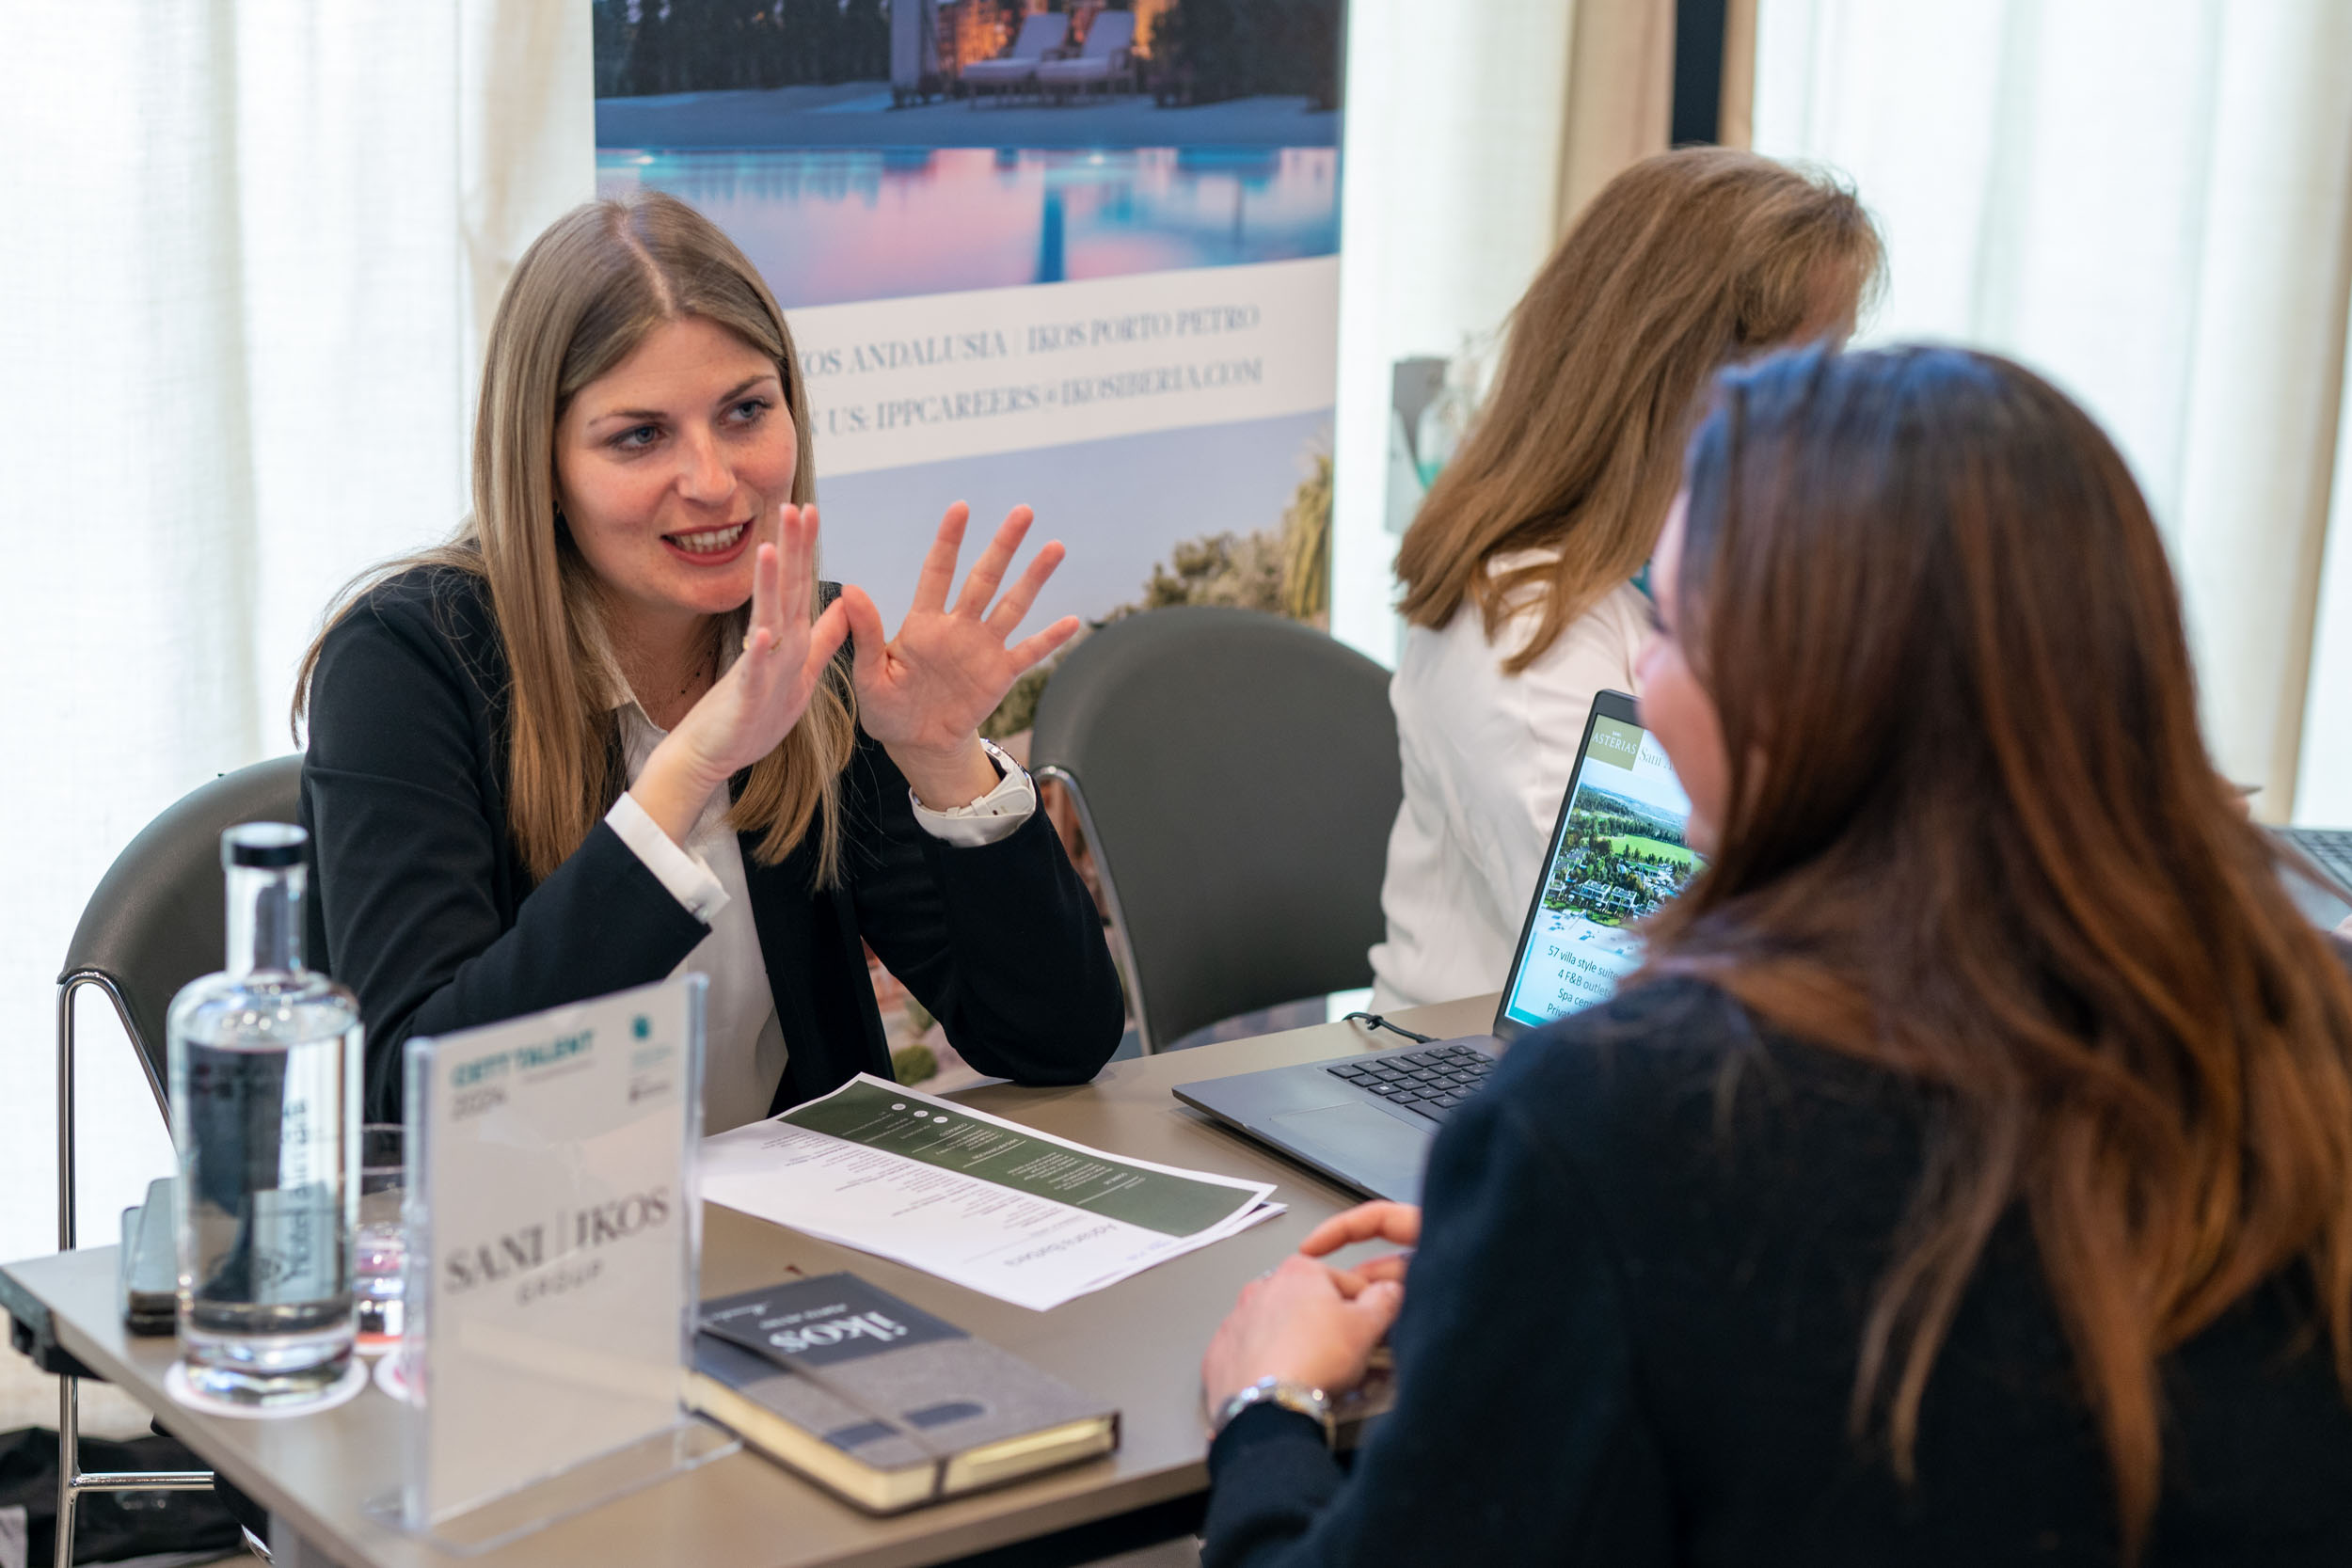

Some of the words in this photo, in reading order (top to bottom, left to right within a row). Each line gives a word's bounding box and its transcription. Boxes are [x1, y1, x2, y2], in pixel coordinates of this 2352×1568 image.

[800, 348, 842, 375] OS
[848, 329, 1009, 374] ANDALUSIA
[1028, 321, 1087, 354] IKOS
[1090, 311, 1173, 347] PORTO
[1176, 304, 1262, 337] PETRO
[1592, 732, 1637, 754] ASTERIAS
[1640, 747, 1663, 767] Sani
[1548, 944, 1560, 958] 57
[1561, 951, 1577, 965] villa
[1577, 958, 1597, 973] style
[1598, 967, 1620, 982] suite
[1558, 969, 1565, 979] 4
[1565, 971, 1582, 987] F&B
[1583, 980, 1613, 998] outlets
[1547, 1002, 1574, 1019] Privat
[1558, 988, 1573, 1002] Spa
[1574, 996, 1594, 1009] cent
[444, 1225, 545, 1295] SANI
[576, 1186, 671, 1248] IKOS
[769, 1310, 908, 1354] ikos
